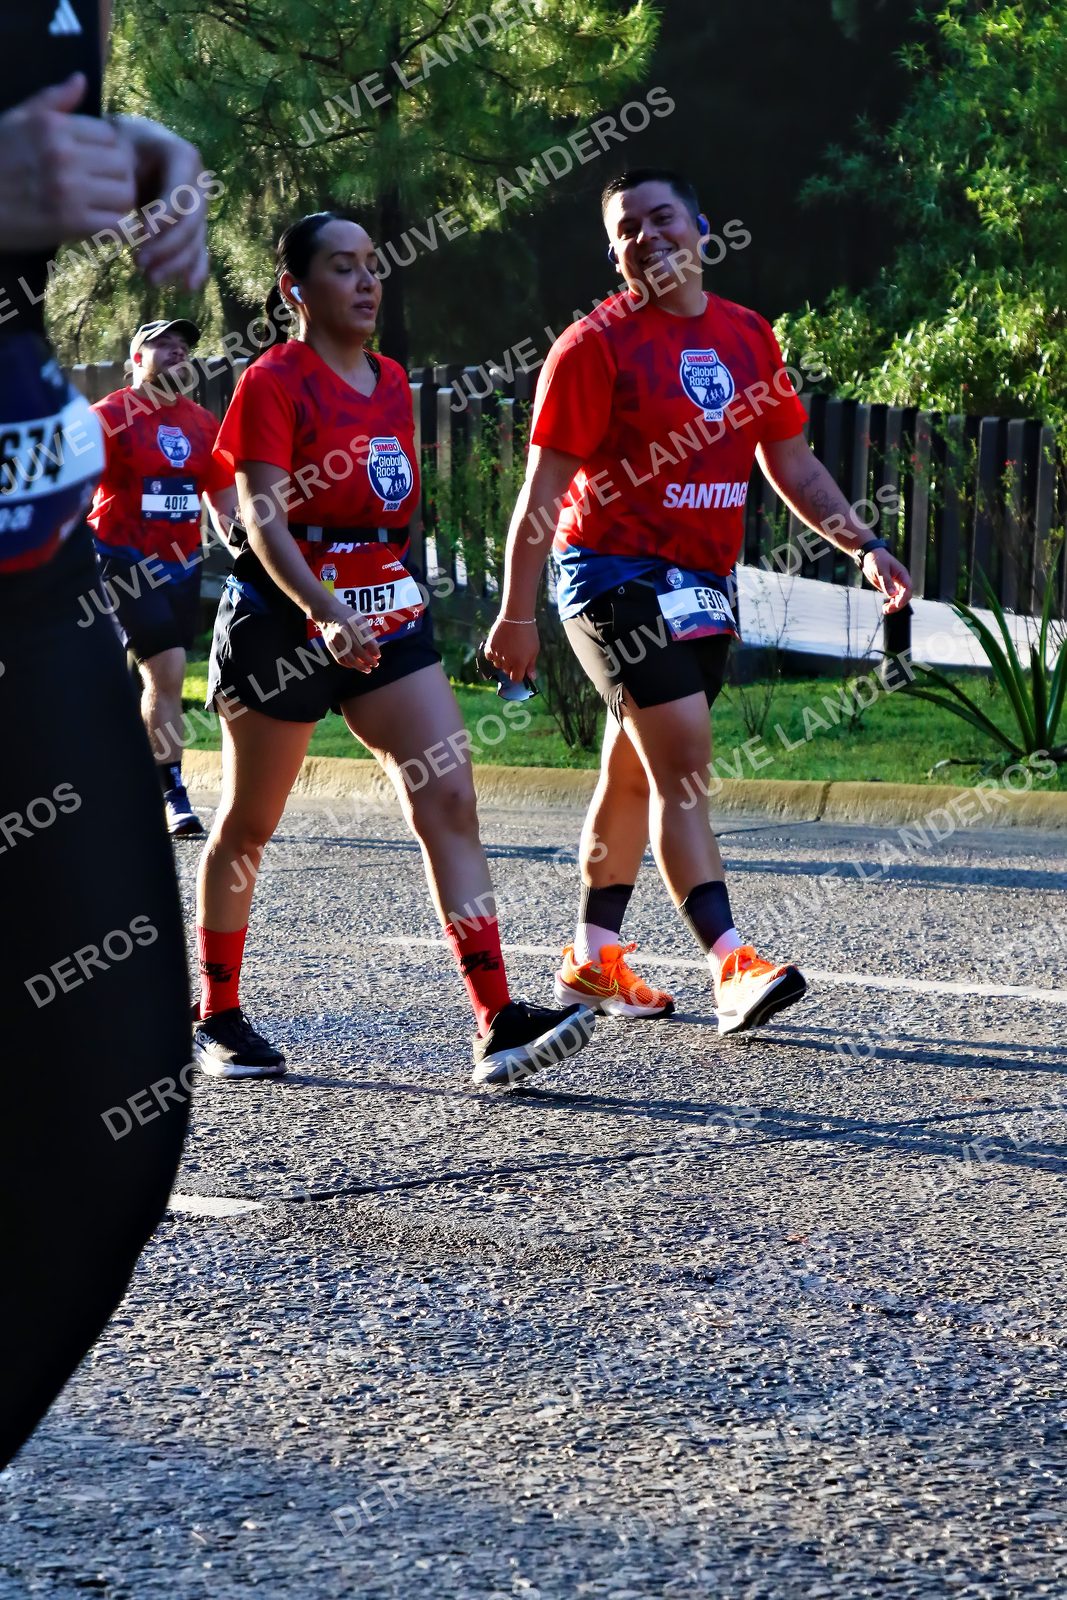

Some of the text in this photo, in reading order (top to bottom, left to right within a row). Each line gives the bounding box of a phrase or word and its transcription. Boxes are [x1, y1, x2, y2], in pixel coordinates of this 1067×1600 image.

[692, 367, 717, 377] Global
[690, 377, 710, 386] Race
[374, 443, 398, 452] BIMBO
[379, 456, 402, 467] Global
[376, 466, 396, 477] Race
[663, 481, 748, 509] SANTIAG
[164, 496, 188, 510] 4012
[343, 584, 395, 614] 3057
[366, 616, 385, 627] 0-26
